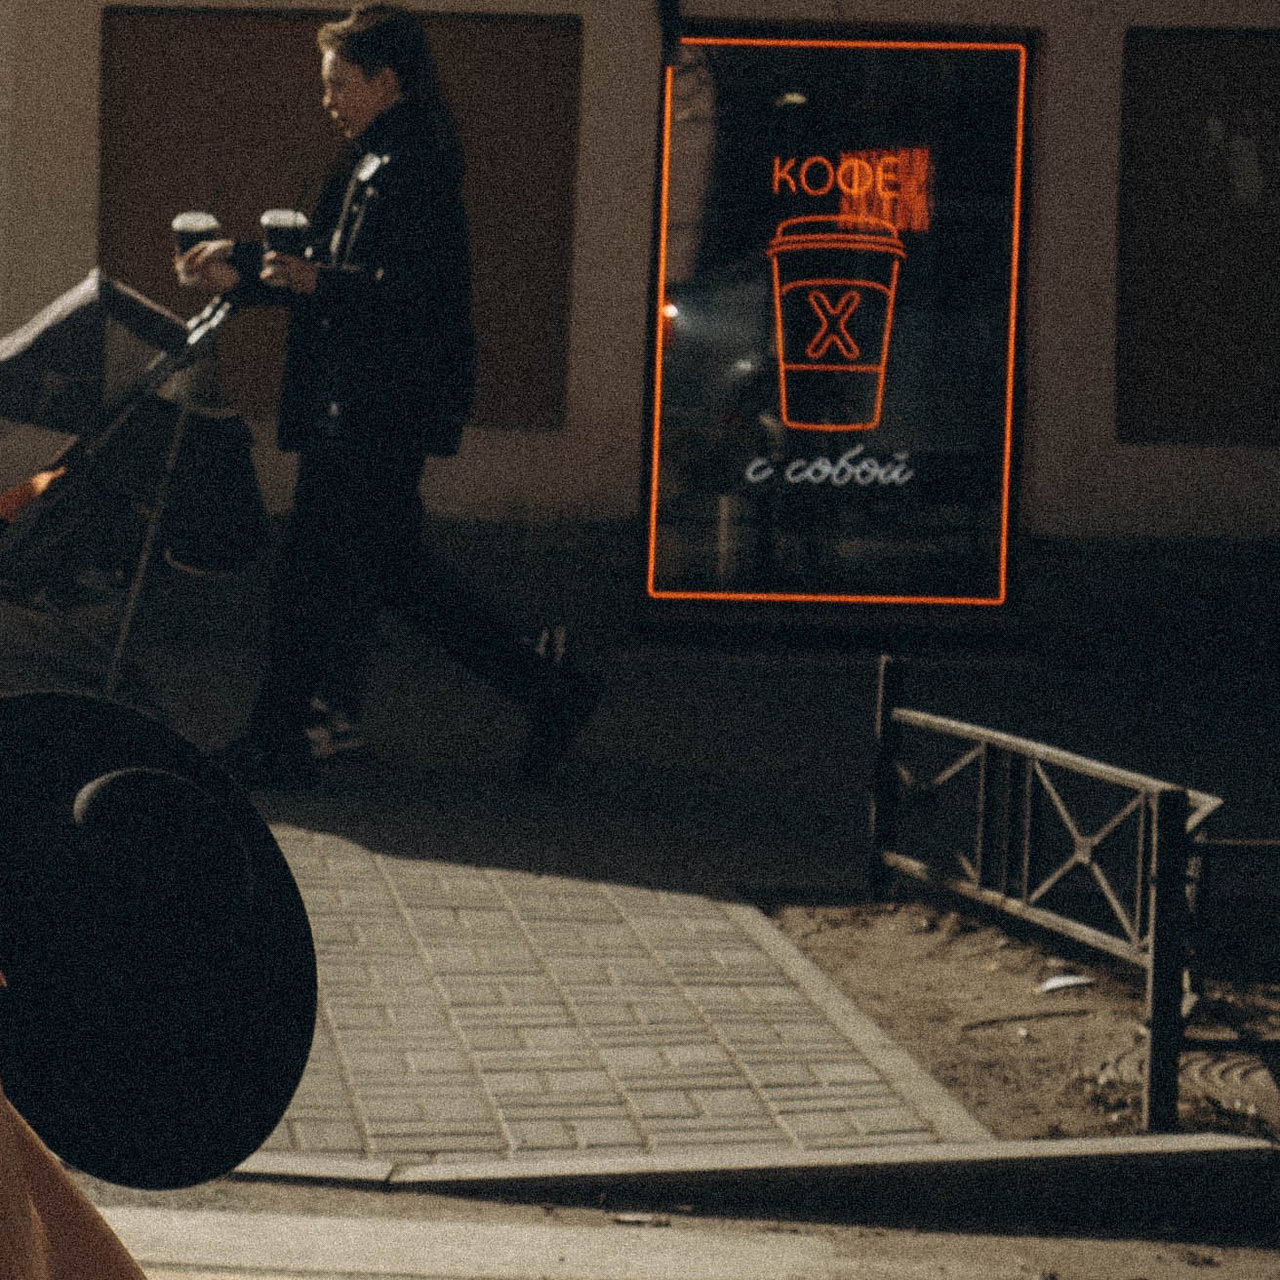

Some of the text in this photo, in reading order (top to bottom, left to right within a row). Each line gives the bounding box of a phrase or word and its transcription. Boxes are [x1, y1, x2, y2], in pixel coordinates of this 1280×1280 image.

[771, 154, 899, 198] КОФЕ
[745, 443, 915, 488] с собой
